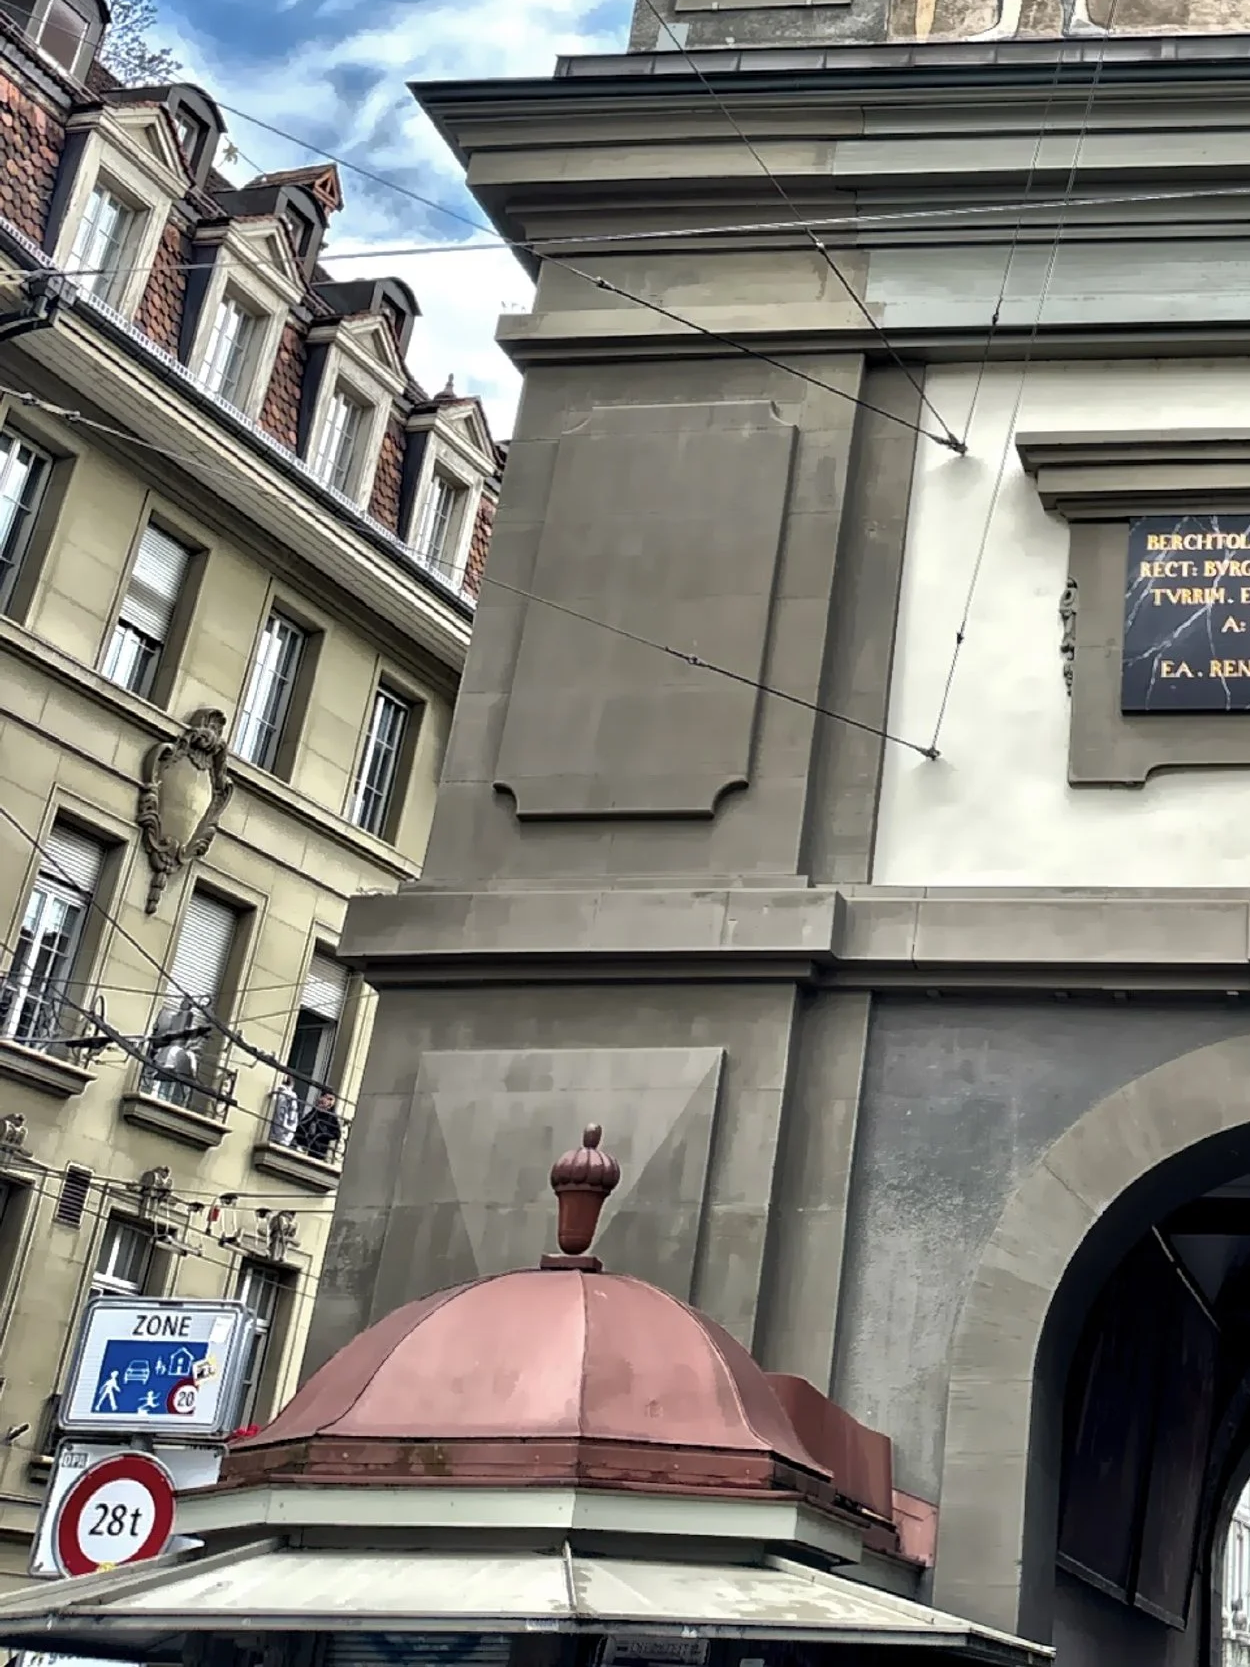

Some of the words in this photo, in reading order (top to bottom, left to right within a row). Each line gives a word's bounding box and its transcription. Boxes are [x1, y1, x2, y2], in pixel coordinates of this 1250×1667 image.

[1140, 560, 1198, 578] RECT:
[133, 1315, 192, 1338] ZONE
[177, 1391, 195, 1407] 20
